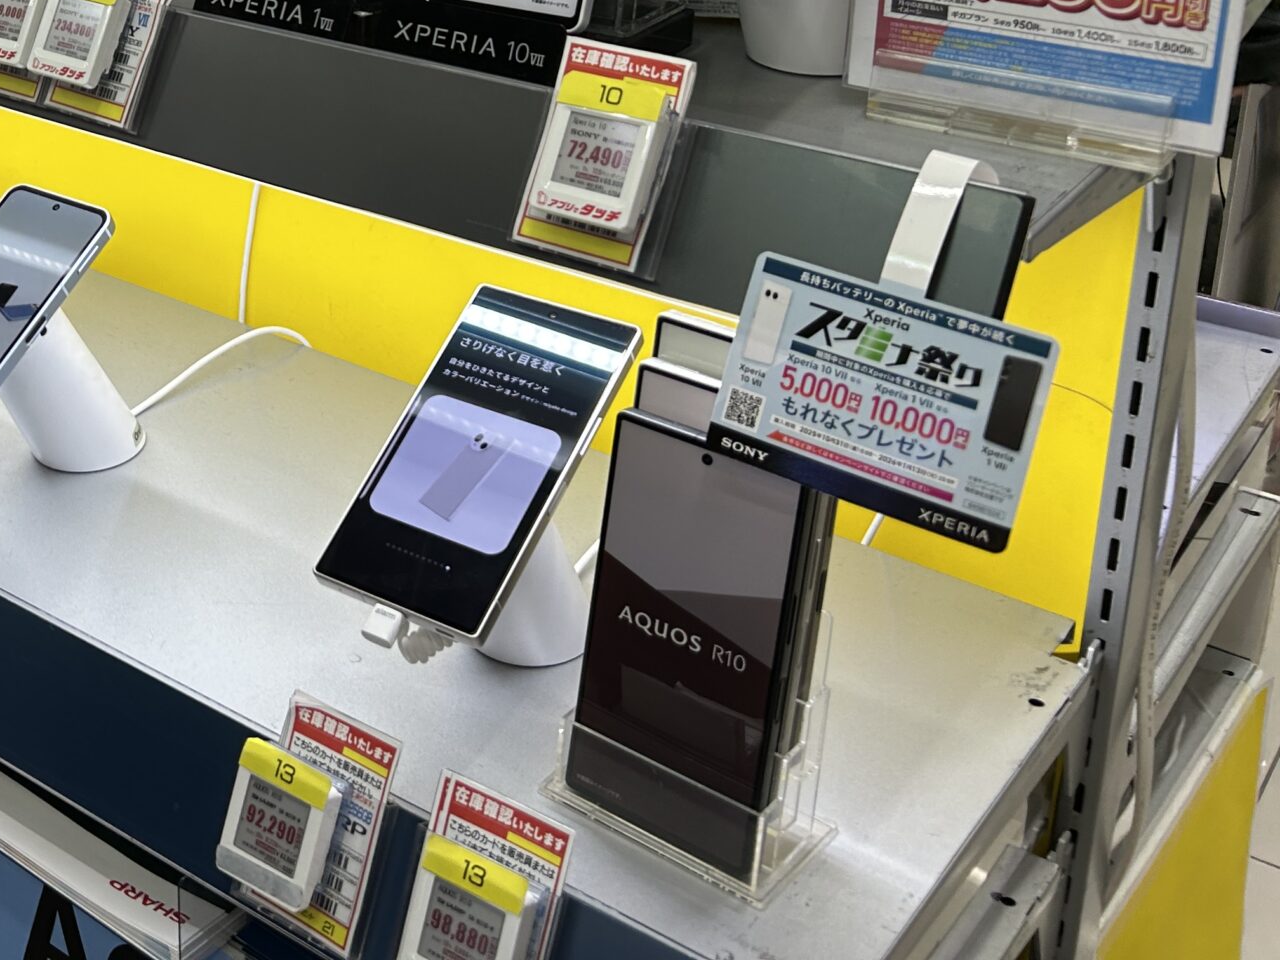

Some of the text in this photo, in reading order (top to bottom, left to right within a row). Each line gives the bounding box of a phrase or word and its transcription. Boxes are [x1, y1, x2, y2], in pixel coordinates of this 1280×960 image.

[394, 20, 496, 58] XPERIA
[571, 46, 682, 82] 在庫確認いたします
[600, 84, 624, 106] 10
[570, 128, 600, 140] SONY
[567, 139, 623, 170] 72,490
[863, 307, 911, 332] Xperia
[459, 336, 566, 377] さりげなく目を惹く
[787, 353, 820, 371] Xperia
[442, 367, 520, 397] カラーバリエーション
[449, 357, 550, 394] 自分をひきたてるデザインと
[780, 364, 863, 411] 5,000円
[782, 395, 954, 468] もれなくプレゼント
[869, 395, 970, 447] 10,000円
[720, 436, 769, 462] SONY
[918, 507, 990, 542] XPERIA
[618, 604, 747, 674] AQUOS R10
[298, 706, 394, 765] 在庫確認いたします
[275, 758, 296, 785] 13
[246, 802, 296, 845] 92,290
[455, 786, 566, 852] 在庫確認いたします
[463, 859, 487, 888] 13
[109, 878, 192, 927] SHARP
[322, 919, 336, 937] 21
[430, 907, 488, 956] 98,880
